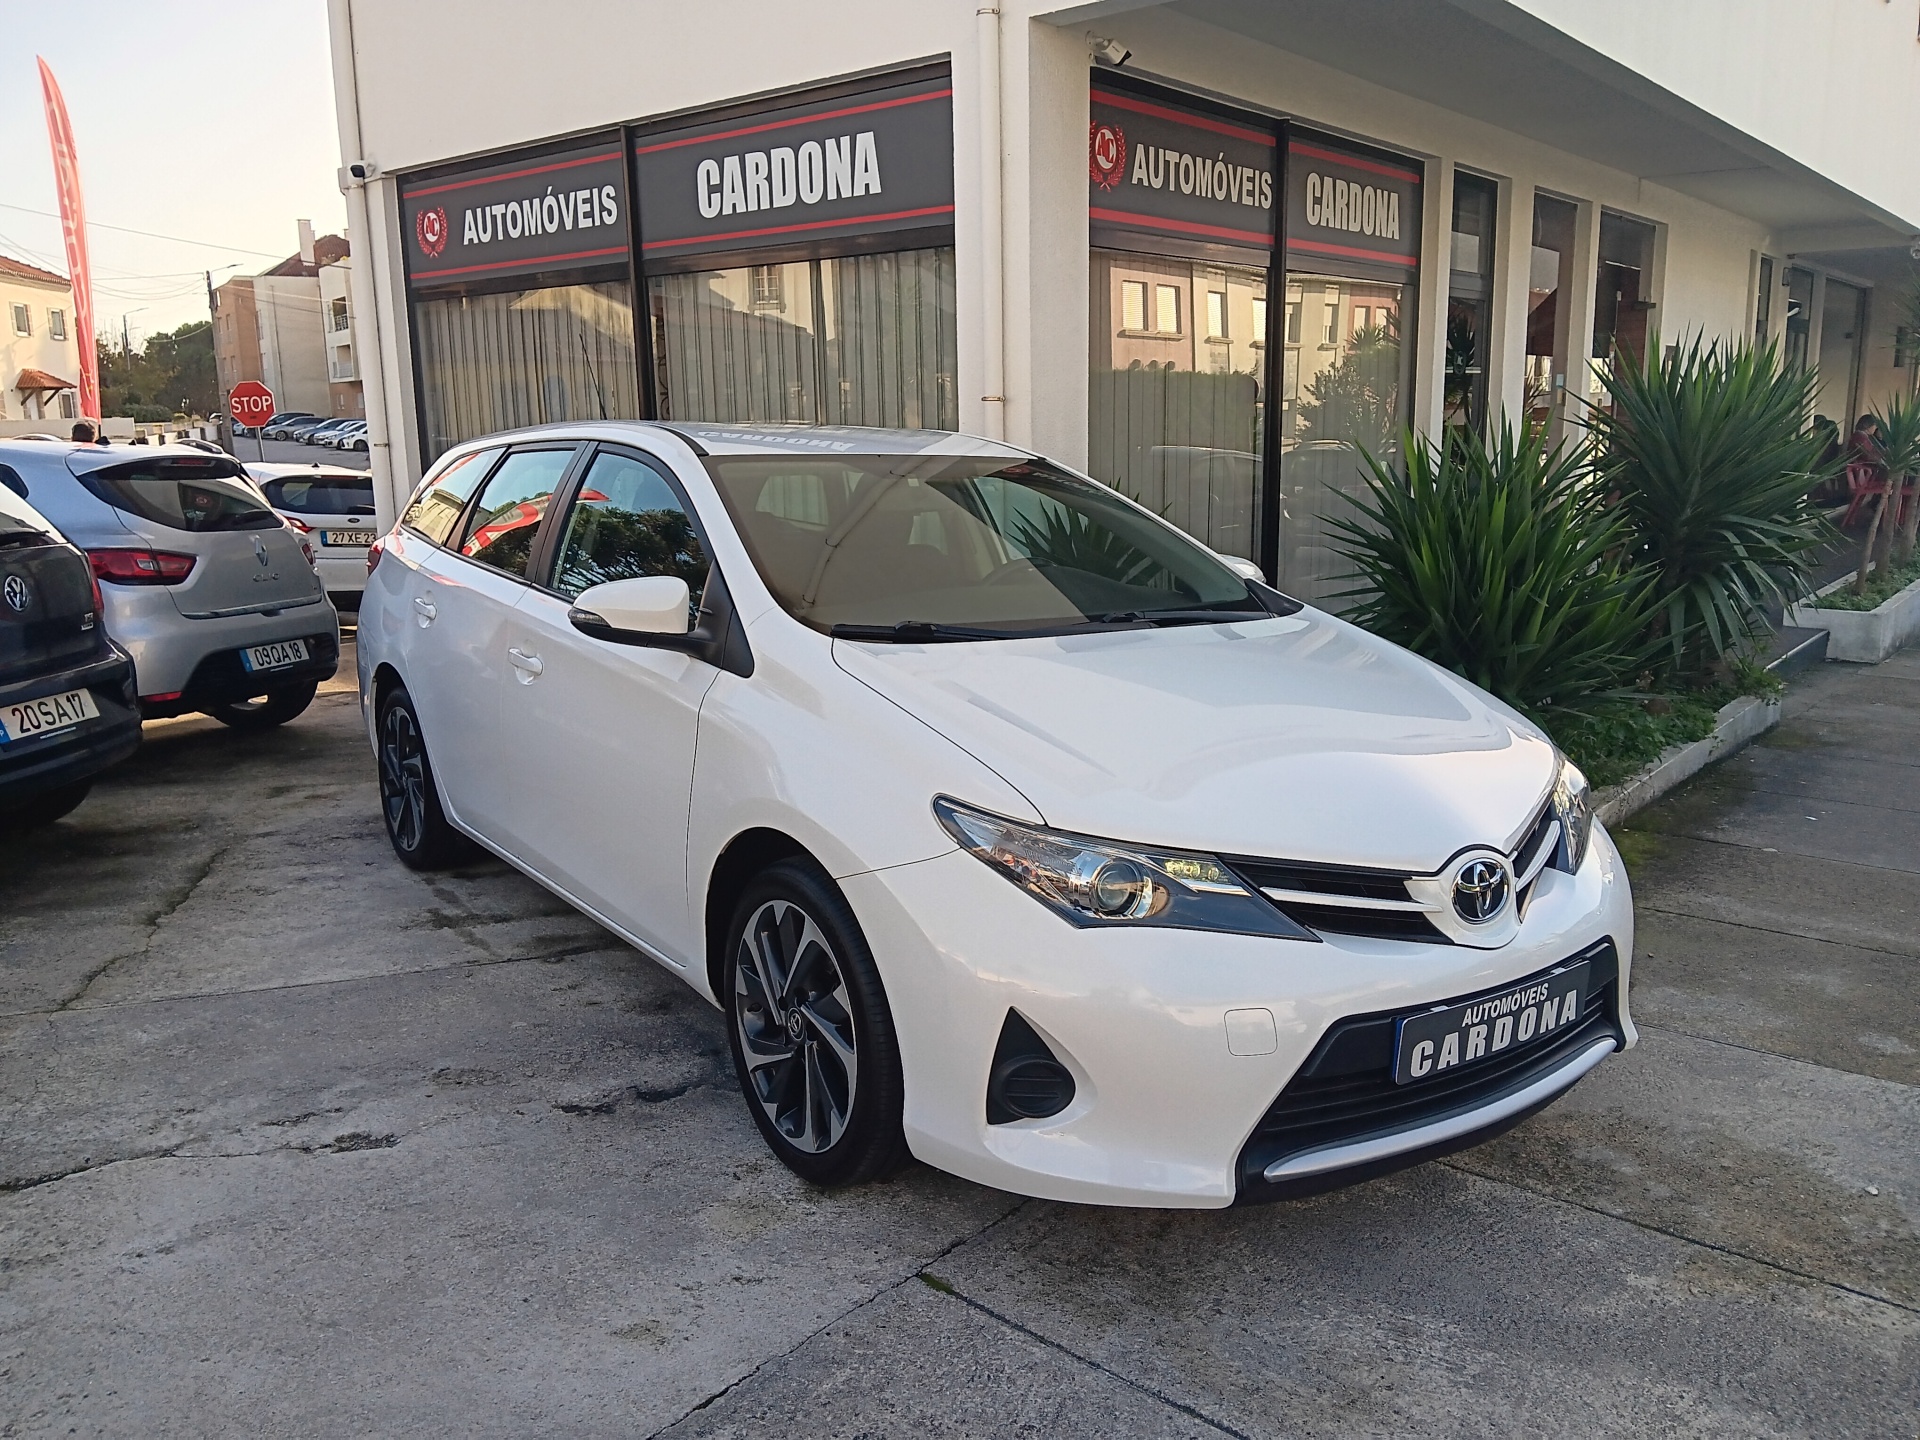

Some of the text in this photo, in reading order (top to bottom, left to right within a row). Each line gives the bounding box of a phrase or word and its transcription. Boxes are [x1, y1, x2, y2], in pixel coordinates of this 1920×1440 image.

[697, 131, 882, 219] CARDONA
[1131, 143, 1273, 210] AUTOMÓVEIS
[1306, 172, 1400, 240] CARDONA
[463, 185, 618, 246] AUTOMÓVEIS
[231, 395, 272, 414] STOP
[1410, 989, 1578, 1078] CARDONA
[1461, 982, 1549, 1028] AUTOMÓVEIS
